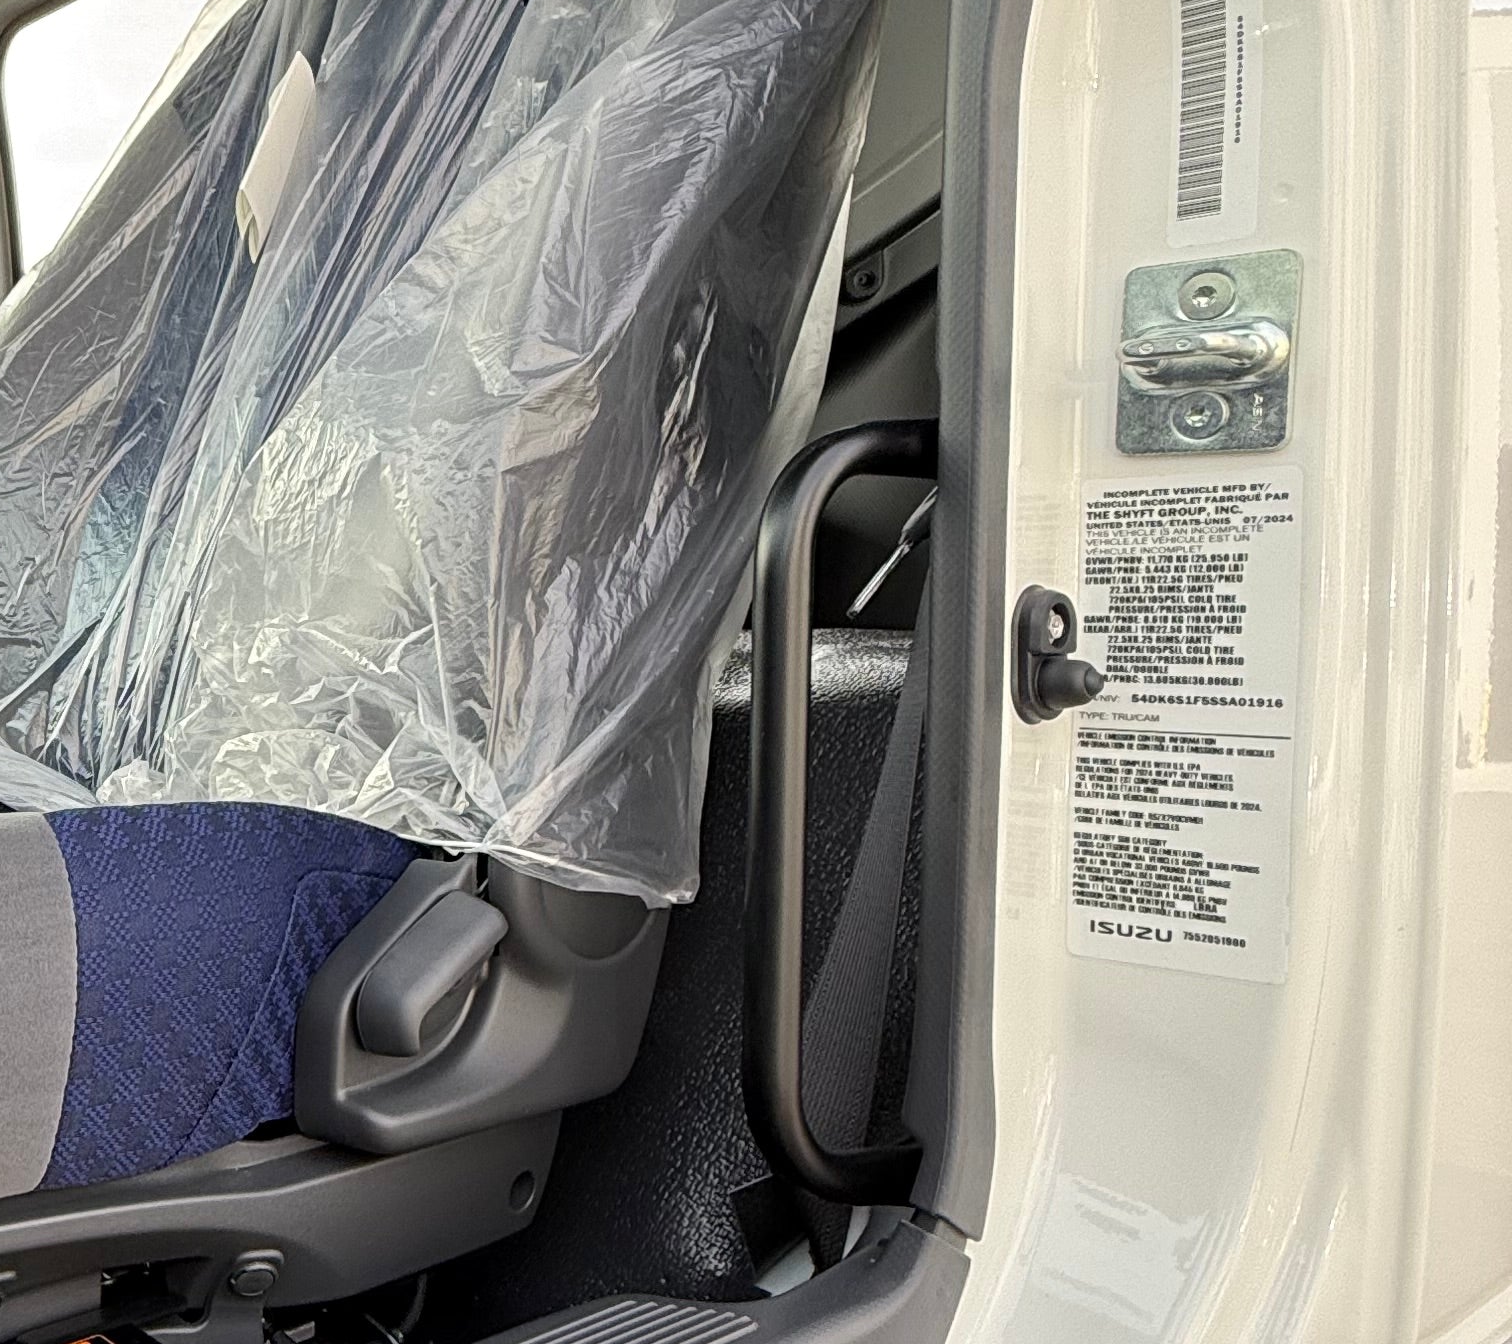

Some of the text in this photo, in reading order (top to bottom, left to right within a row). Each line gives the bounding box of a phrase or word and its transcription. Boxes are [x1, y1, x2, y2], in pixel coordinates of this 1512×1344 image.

[1104, 483, 1272, 498] INCOMPLETE VEHICLE MFD BY/
[1140, 497, 1202, 507] INCOMPLET
[1265, 492, 1289, 501] PAR
[1087, 505, 1243, 520] THE SHYFT GROUP, INC.
[1087, 521, 1123, 530] UNITED
[1243, 514, 1294, 526] 07/2024
[1087, 524, 1264, 538] THIS VEHICLE IS AN INCOMPLETE
[1209, 534, 1230, 543] EST
[1234, 534, 1250, 542] UN
[1140, 544, 1203, 554] INCOMPLET
[1176, 554, 1189, 563] KG
[1174, 565, 1186, 573] KG
[1186, 574, 1243, 583] TIRES/PNEU
[1188, 594, 1213, 604] COLD
[1216, 594, 1237, 603] TIRE
[1108, 604, 1206, 614] PRESSURE/PRESSION
[1217, 604, 1247, 613] FROID
[1171, 615, 1184, 624] KG
[1185, 625, 1242, 635] TIRES/PNEU
[1186, 645, 1211, 655] COLD
[1213, 646, 1235, 655] TIRE
[1106, 655, 1204, 665] PRESSURE/PRESSION
[1215, 656, 1245, 666] FROID
[1131, 693, 1283, 708] 54DK6S1F5SSA01916
[1079, 711, 1108, 720] TYPE:
[1187, 763, 1201, 771] EPA
[1090, 919, 1173, 943] ISUZU
